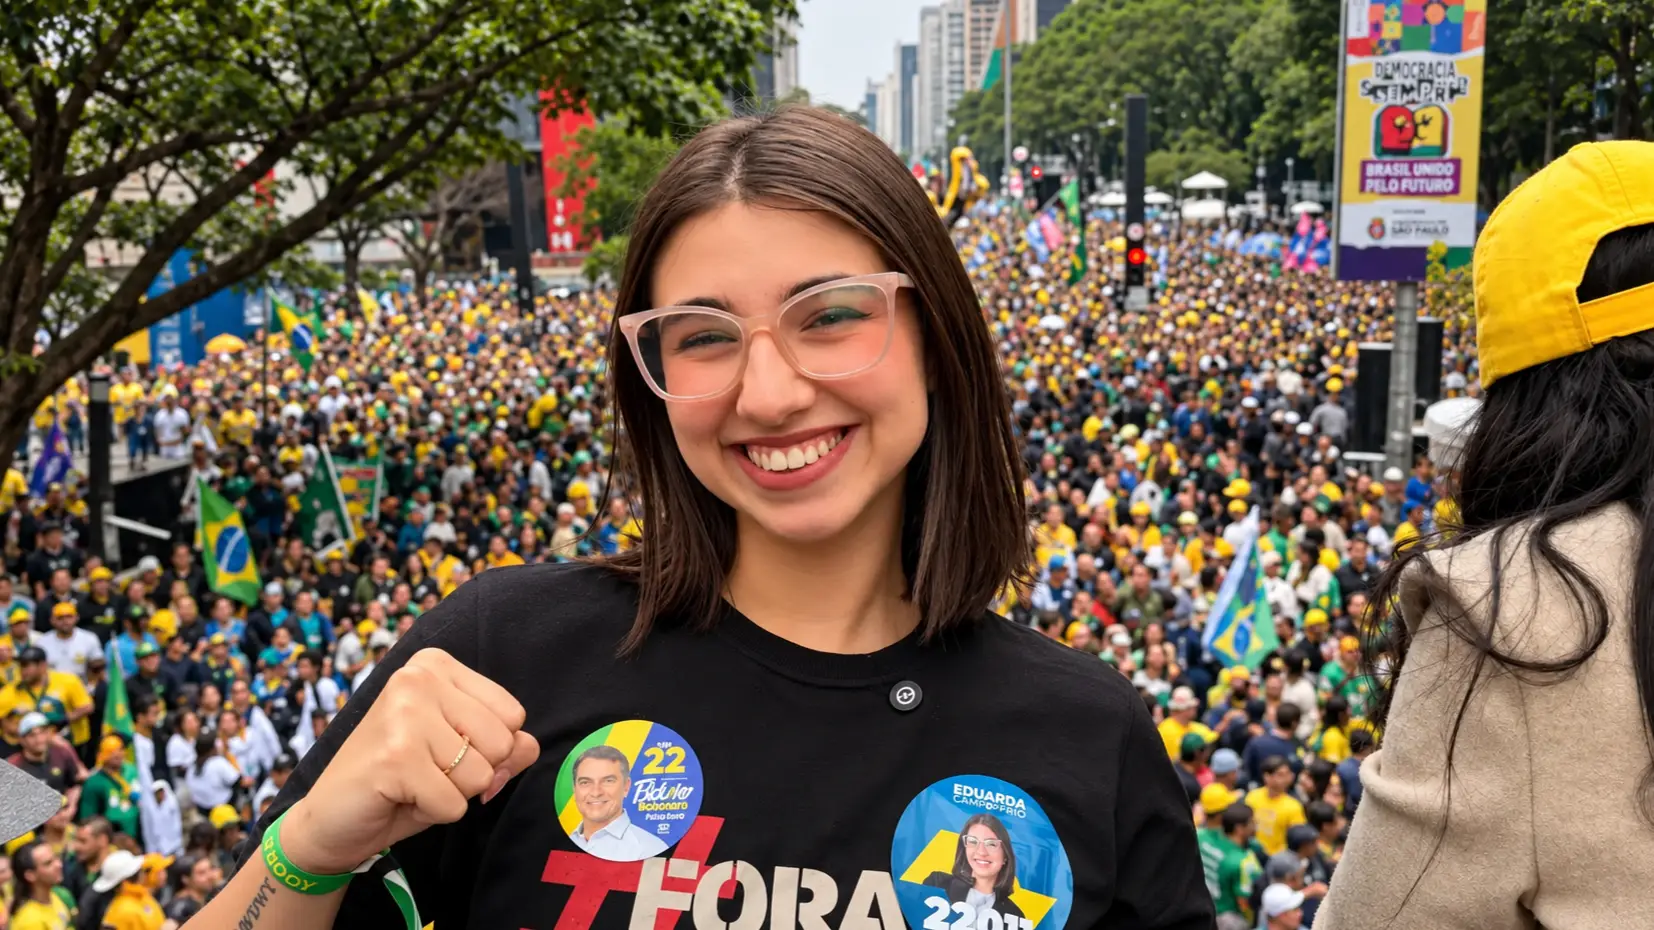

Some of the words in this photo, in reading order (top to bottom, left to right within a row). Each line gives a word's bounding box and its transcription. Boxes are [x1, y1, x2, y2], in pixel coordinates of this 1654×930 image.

[1375, 61, 1456, 78] DEMOCRACIA
[1366, 162, 1411, 177] BRASIL
[1413, 161, 1455, 177] UNIDO
[1365, 178, 1399, 193] PELO
[1400, 178, 1455, 193] FUTURO
[643, 746, 686, 775] 22
[953, 778, 1026, 811] EDUARDA
